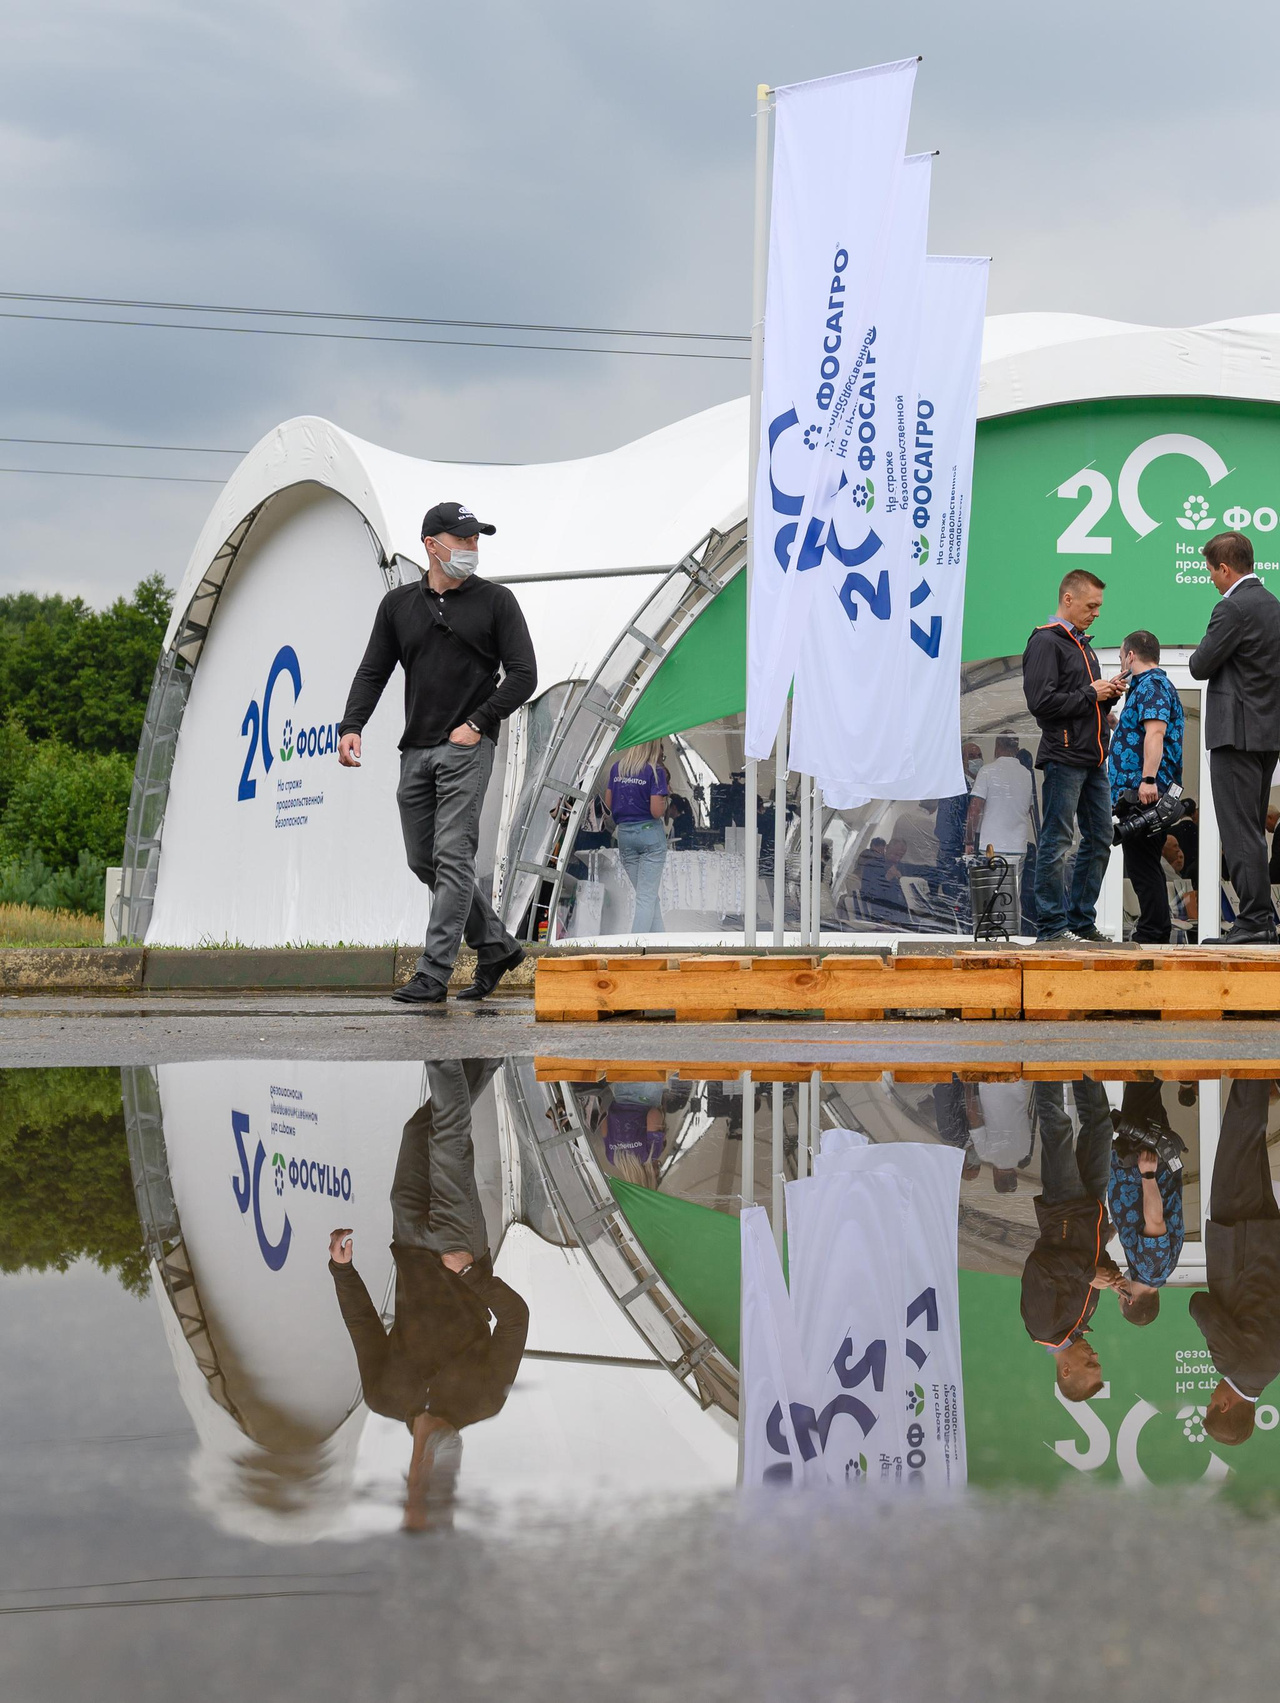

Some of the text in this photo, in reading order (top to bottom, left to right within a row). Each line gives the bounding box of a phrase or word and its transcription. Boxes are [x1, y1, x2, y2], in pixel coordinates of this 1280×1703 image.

[936, 512, 948, 566] На страже
[1176, 543, 1195, 555] На
[296, 722, 341, 759] ФОСАГ
[277, 778, 303, 794] На страже
[276, 791, 324, 815] продовольственной
[275, 813, 309, 829] безопасности
